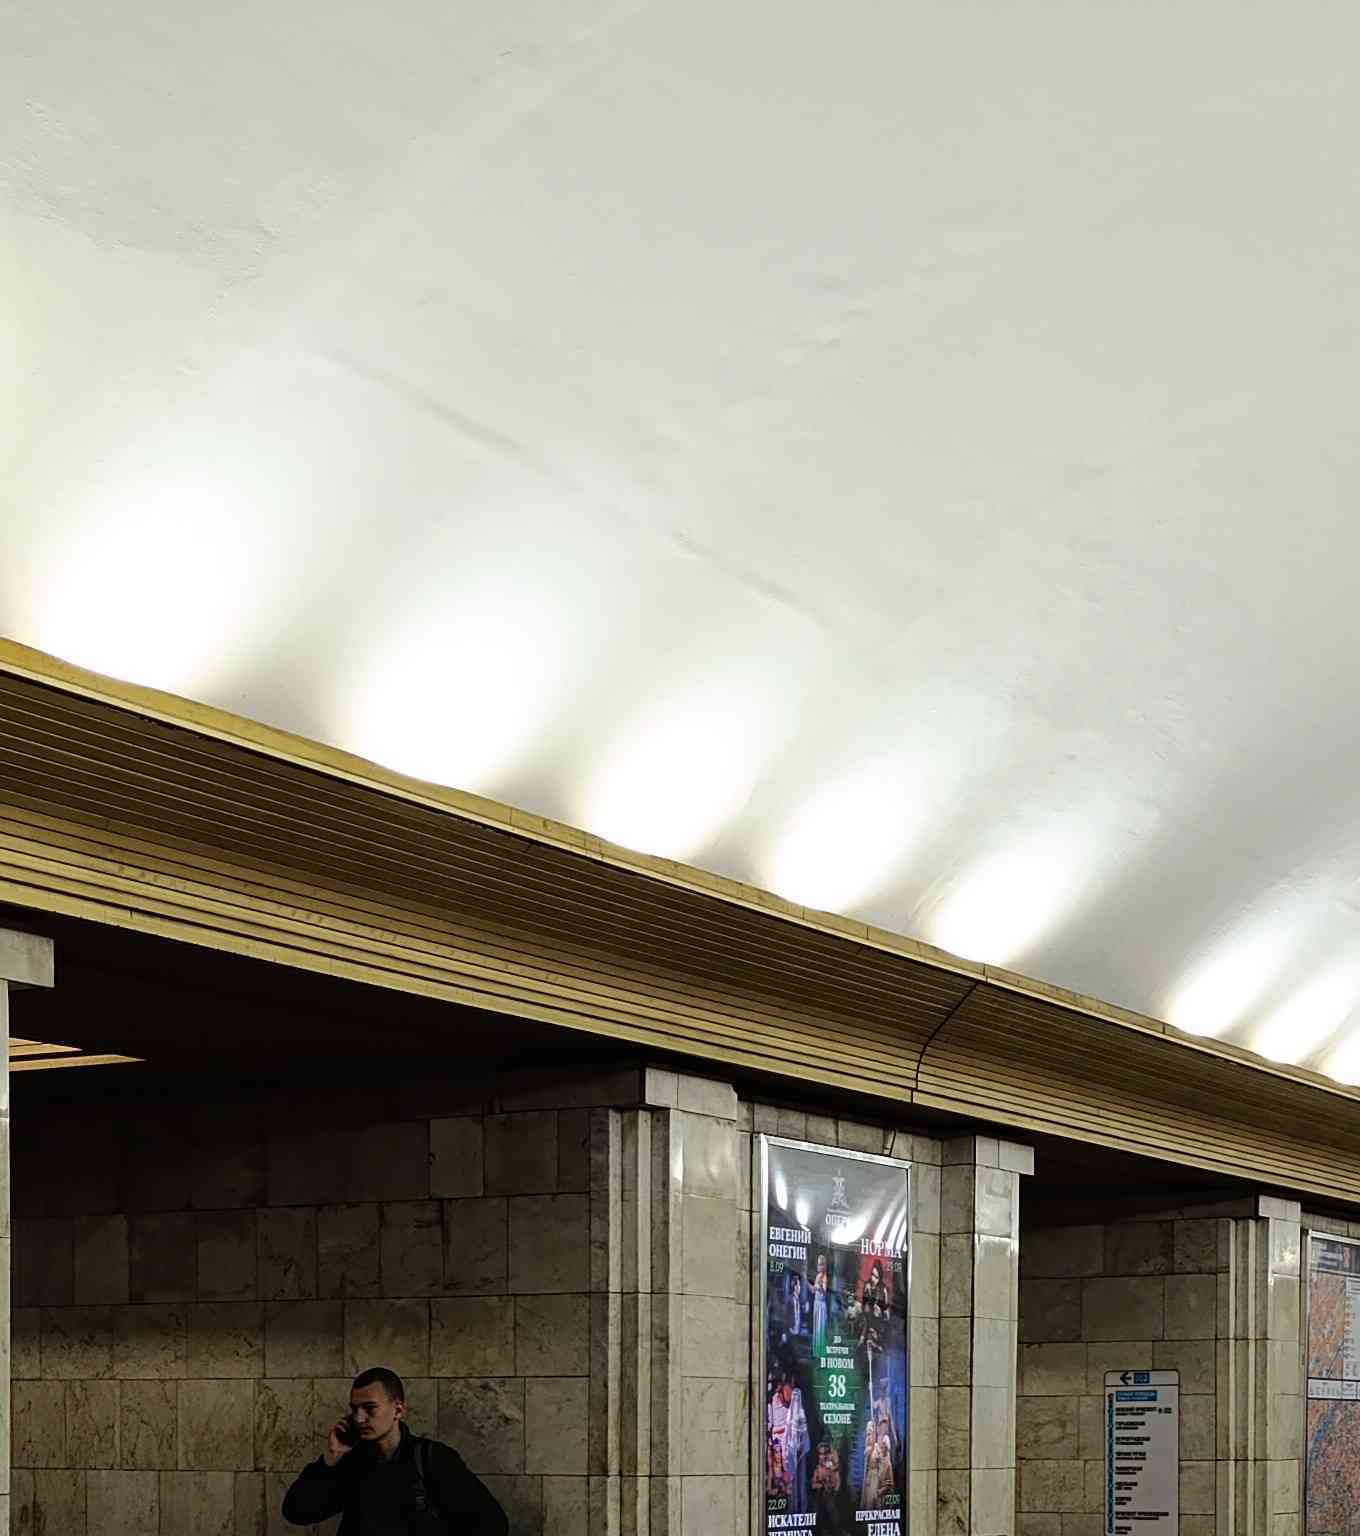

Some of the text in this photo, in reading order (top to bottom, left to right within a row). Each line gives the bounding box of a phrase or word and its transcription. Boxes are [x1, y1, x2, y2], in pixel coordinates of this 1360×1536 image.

[768, 1243, 807, 1260] ОНЕГИН
[861, 1238, 902, 1259] НОРМА
[827, 1358, 854, 1369] НОВОМ
[828, 1374, 846, 1398] 38
[823, 1413, 852, 1425] СЕЗОНЕ
[768, 1513, 817, 1528] ИСКАТЕЛИ
